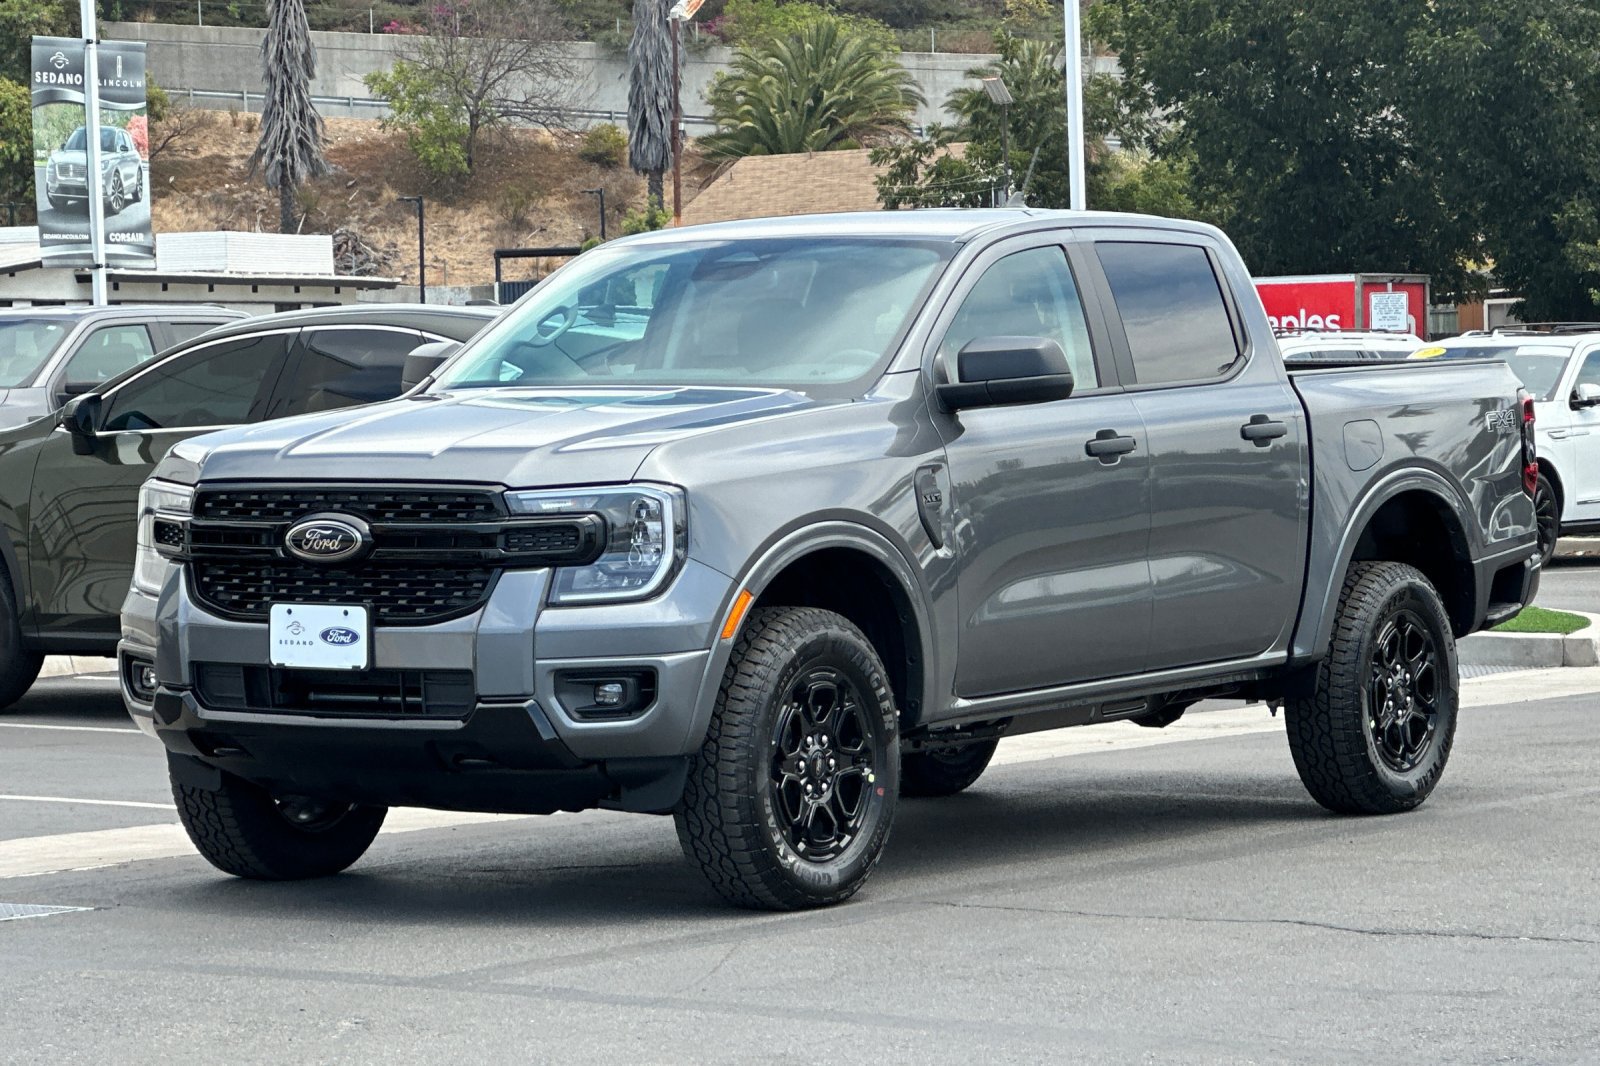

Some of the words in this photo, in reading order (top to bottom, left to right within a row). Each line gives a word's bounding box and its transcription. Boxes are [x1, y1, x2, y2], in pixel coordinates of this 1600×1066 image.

[35, 71, 82, 85] SEDANO
[109, 232, 144, 242] CORSAIR
[1485, 409, 1516, 433] FX4
[302, 528, 343, 551] Ford
[327, 629, 353, 644] Ford
